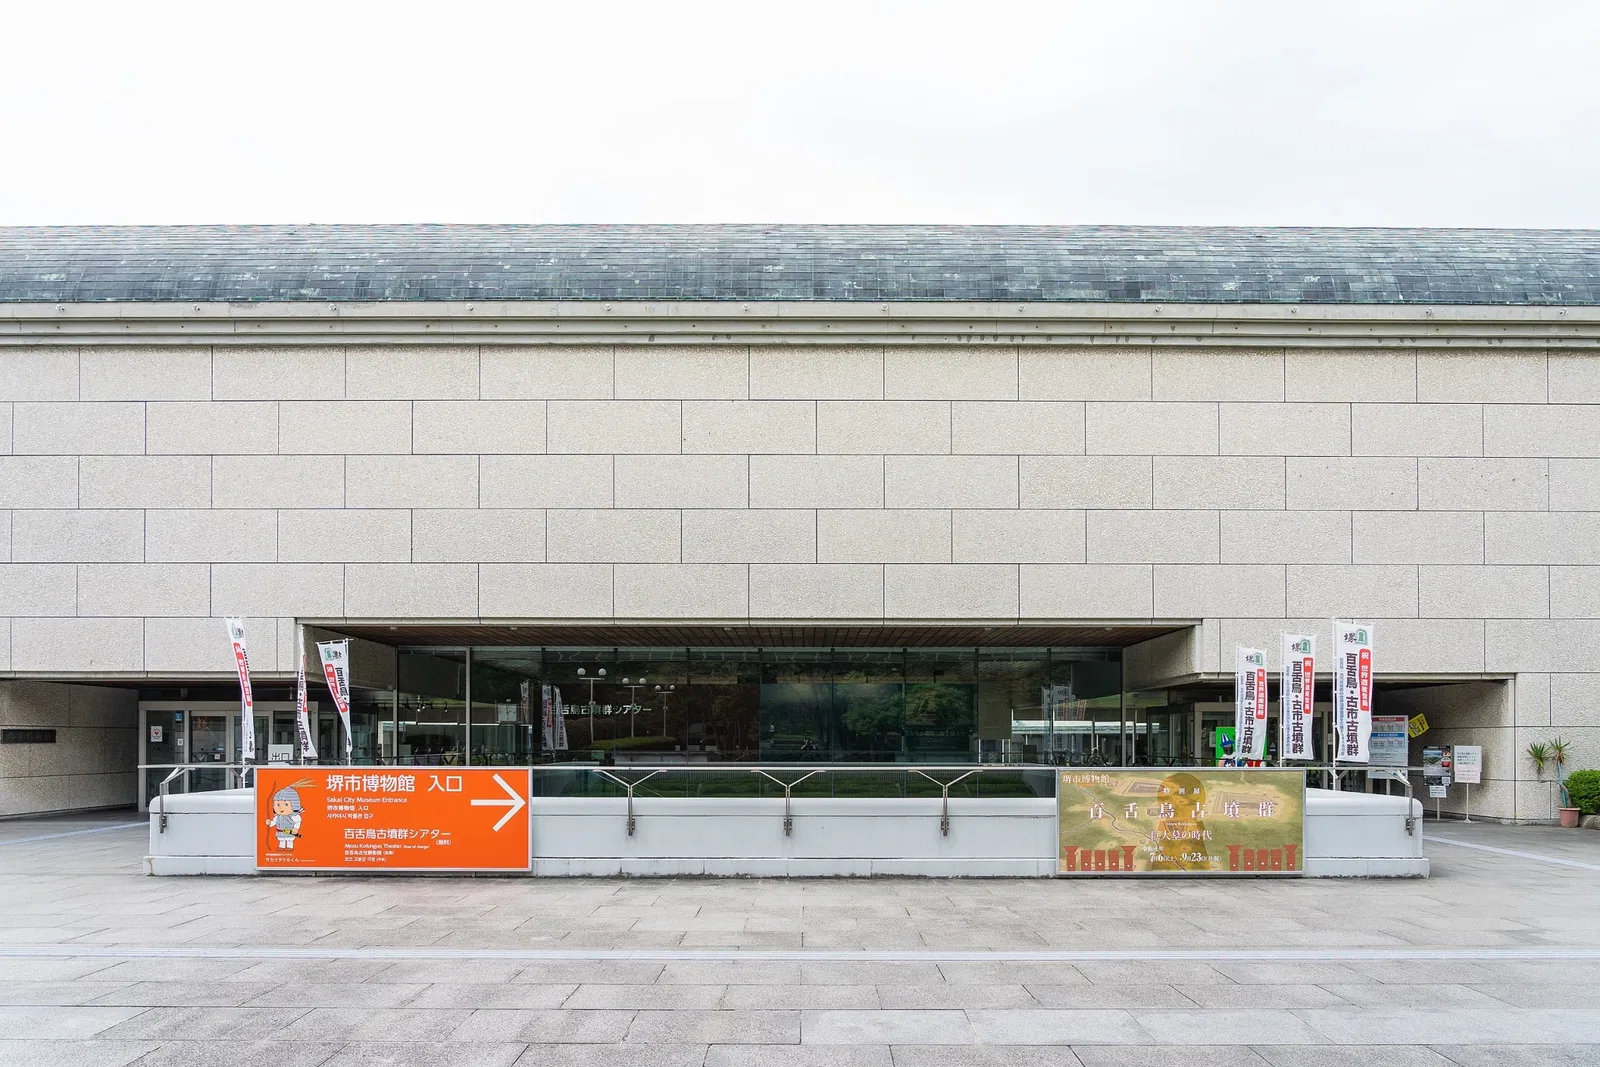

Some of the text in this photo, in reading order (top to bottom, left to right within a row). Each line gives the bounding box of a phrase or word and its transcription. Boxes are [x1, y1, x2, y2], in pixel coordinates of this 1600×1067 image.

[326, 774, 463, 792] 堺市博物館 入口
[1063, 774, 1110, 784] 堺市博物館
[343, 796, 355, 804] City
[1090, 801, 1274, 819] 百舌鳥古墳群
[344, 828, 451, 839] 百舌鳥古墳群シアター
